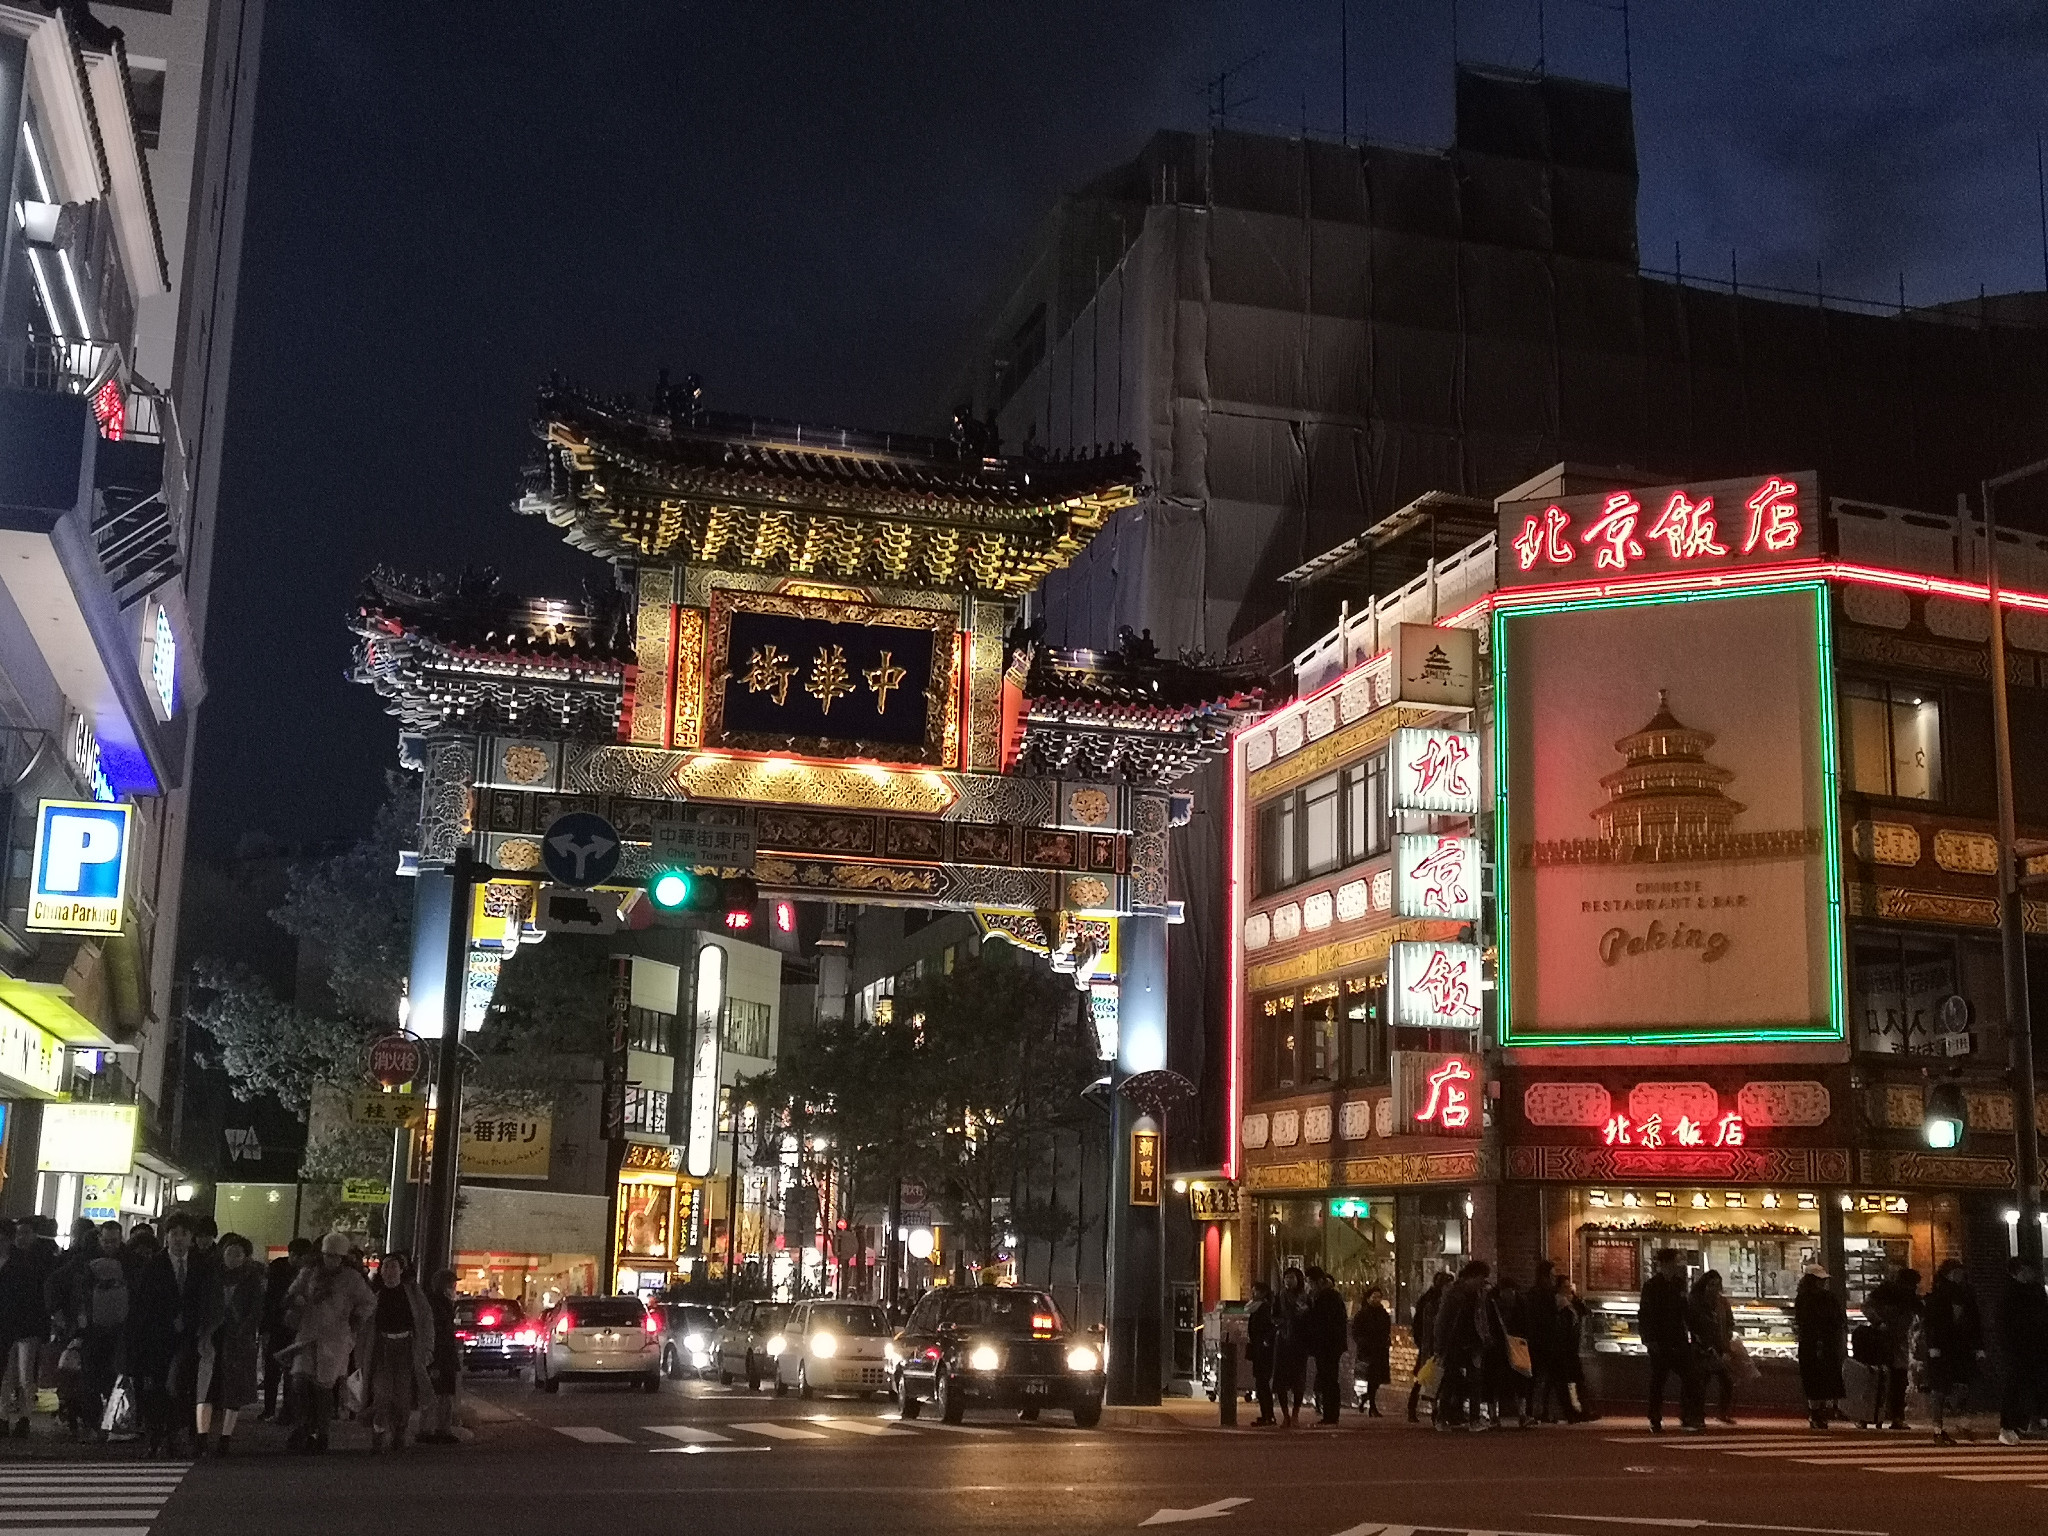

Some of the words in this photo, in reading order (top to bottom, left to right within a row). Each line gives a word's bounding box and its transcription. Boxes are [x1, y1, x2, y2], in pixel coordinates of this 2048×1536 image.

[1513, 476, 1802, 570] 北京飯店
[660, 827, 750, 850] 中華街東門
[45, 814, 119, 892] P
[666, 847, 696, 859] China
[701, 850, 728, 862] Town
[1635, 881, 1703, 894] CHINESE
[1581, 896, 1692, 912] RESTAURANT
[1697, 896, 1707, 910] &
[1711, 894, 1749, 909] BAR
[1598, 918, 1732, 967] Peking
[373, 1050, 416, 1071] 消火栓
[1602, 1112, 1746, 1149] 北京飯店
